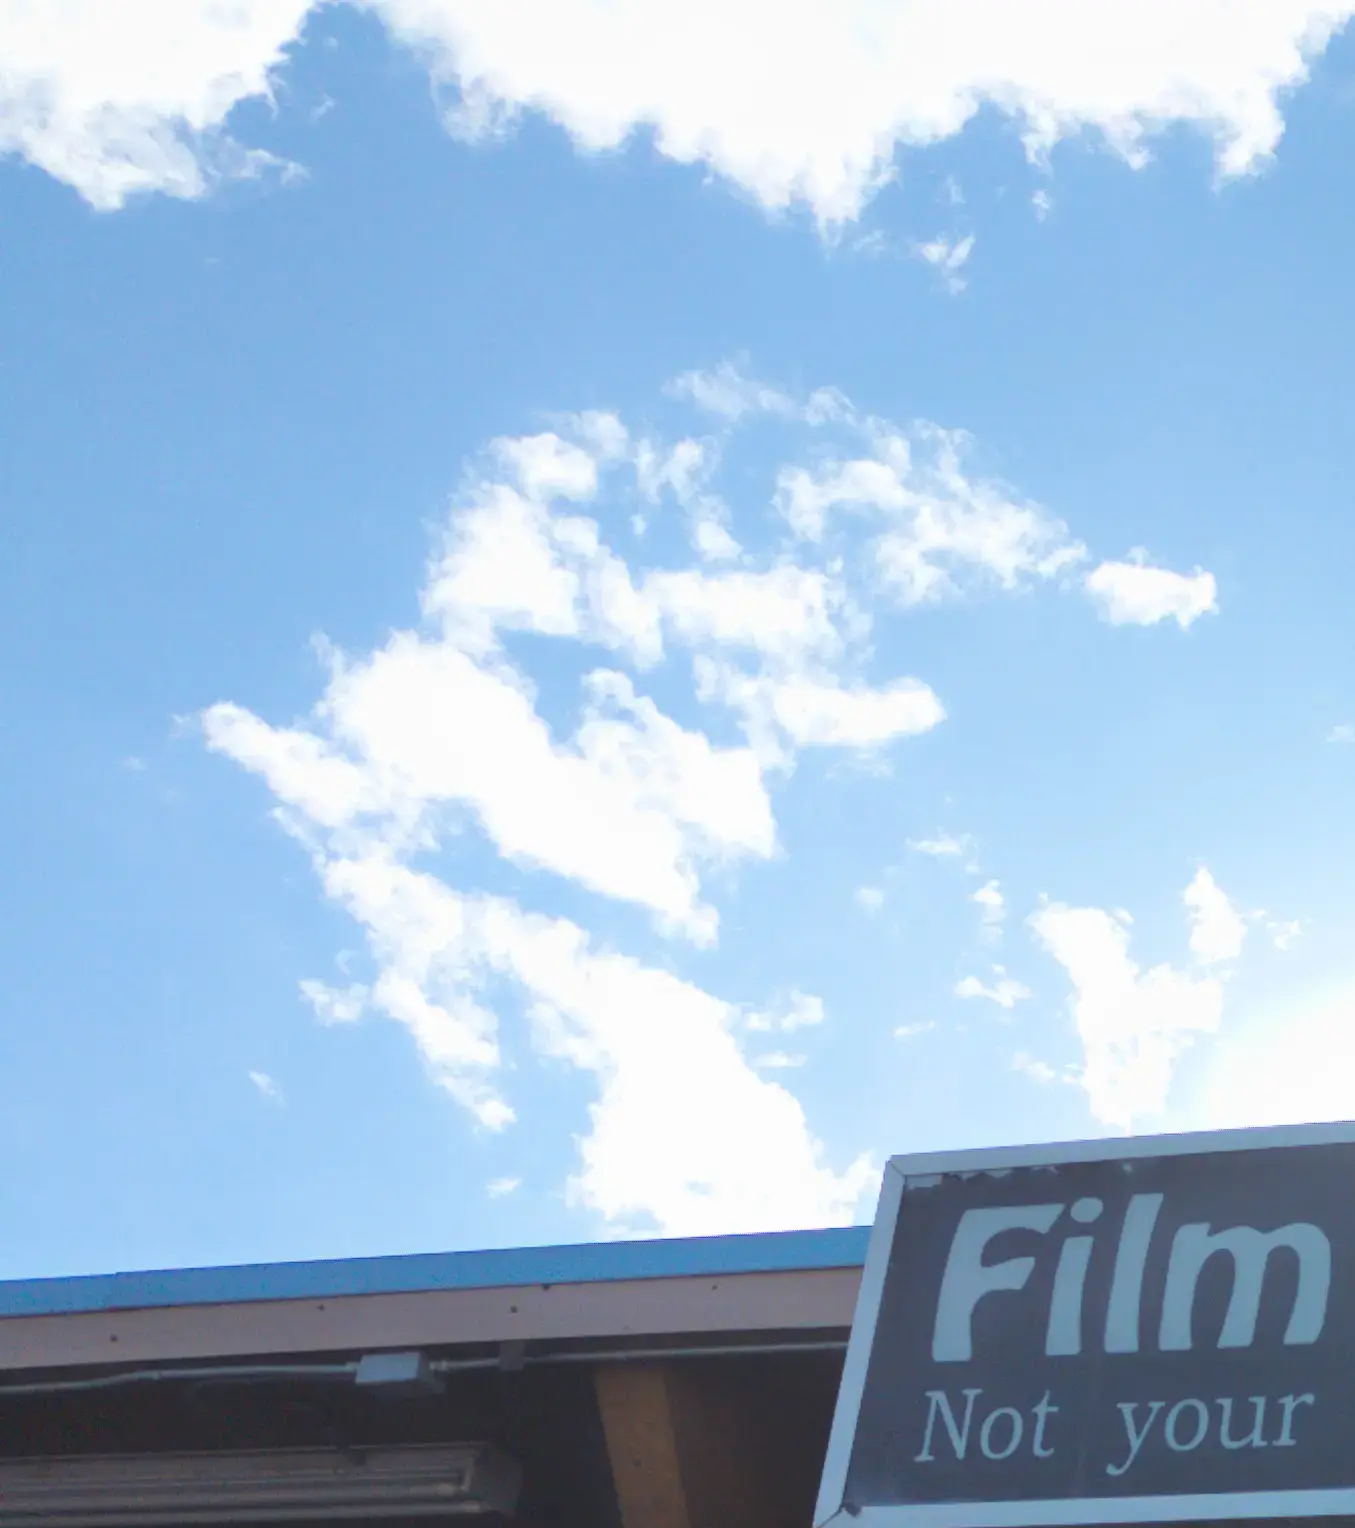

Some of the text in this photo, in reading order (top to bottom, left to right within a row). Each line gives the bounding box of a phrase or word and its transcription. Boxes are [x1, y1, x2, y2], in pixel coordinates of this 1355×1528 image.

[932, 1192, 1331, 1362] Film
[914, 1388, 1059, 1462] Not
[1106, 1391, 1314, 1475] your
